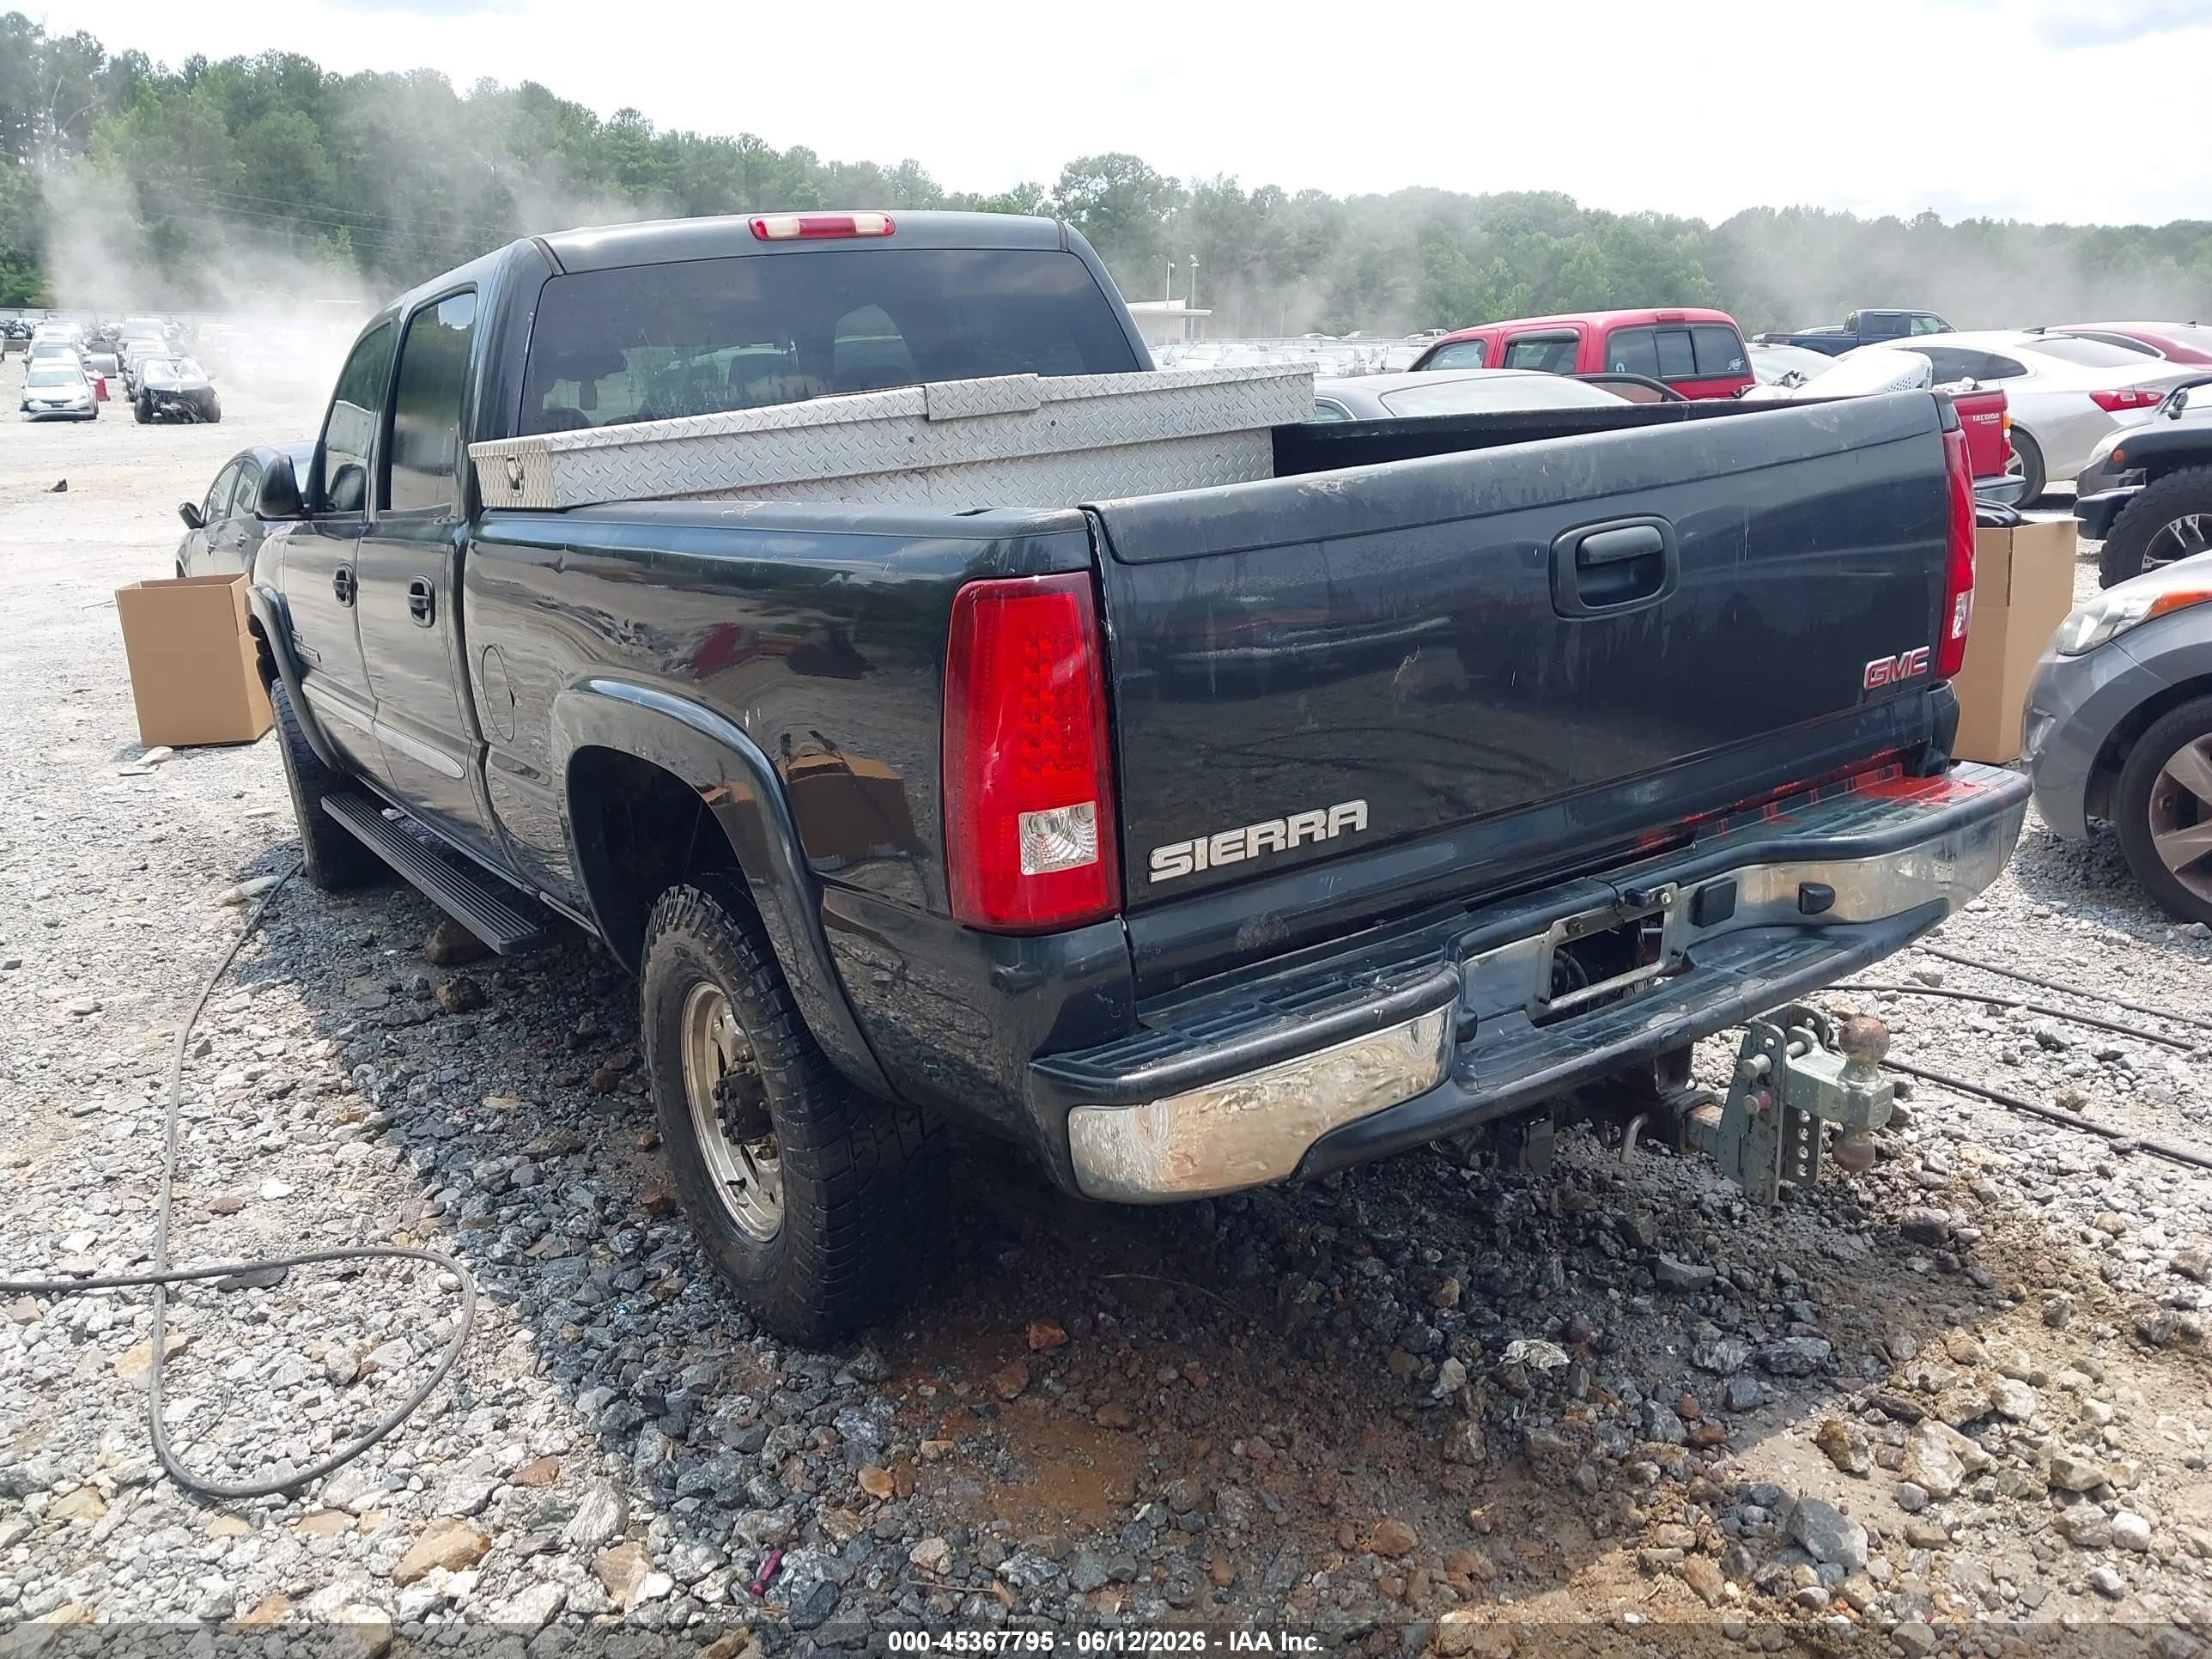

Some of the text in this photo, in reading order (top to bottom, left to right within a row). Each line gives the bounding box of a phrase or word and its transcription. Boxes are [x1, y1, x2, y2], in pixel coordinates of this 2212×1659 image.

[1972, 413, 2000, 422] TACOMA
[1863, 646, 1930, 690] GMC
[1150, 799, 1368, 883] SIERRA
